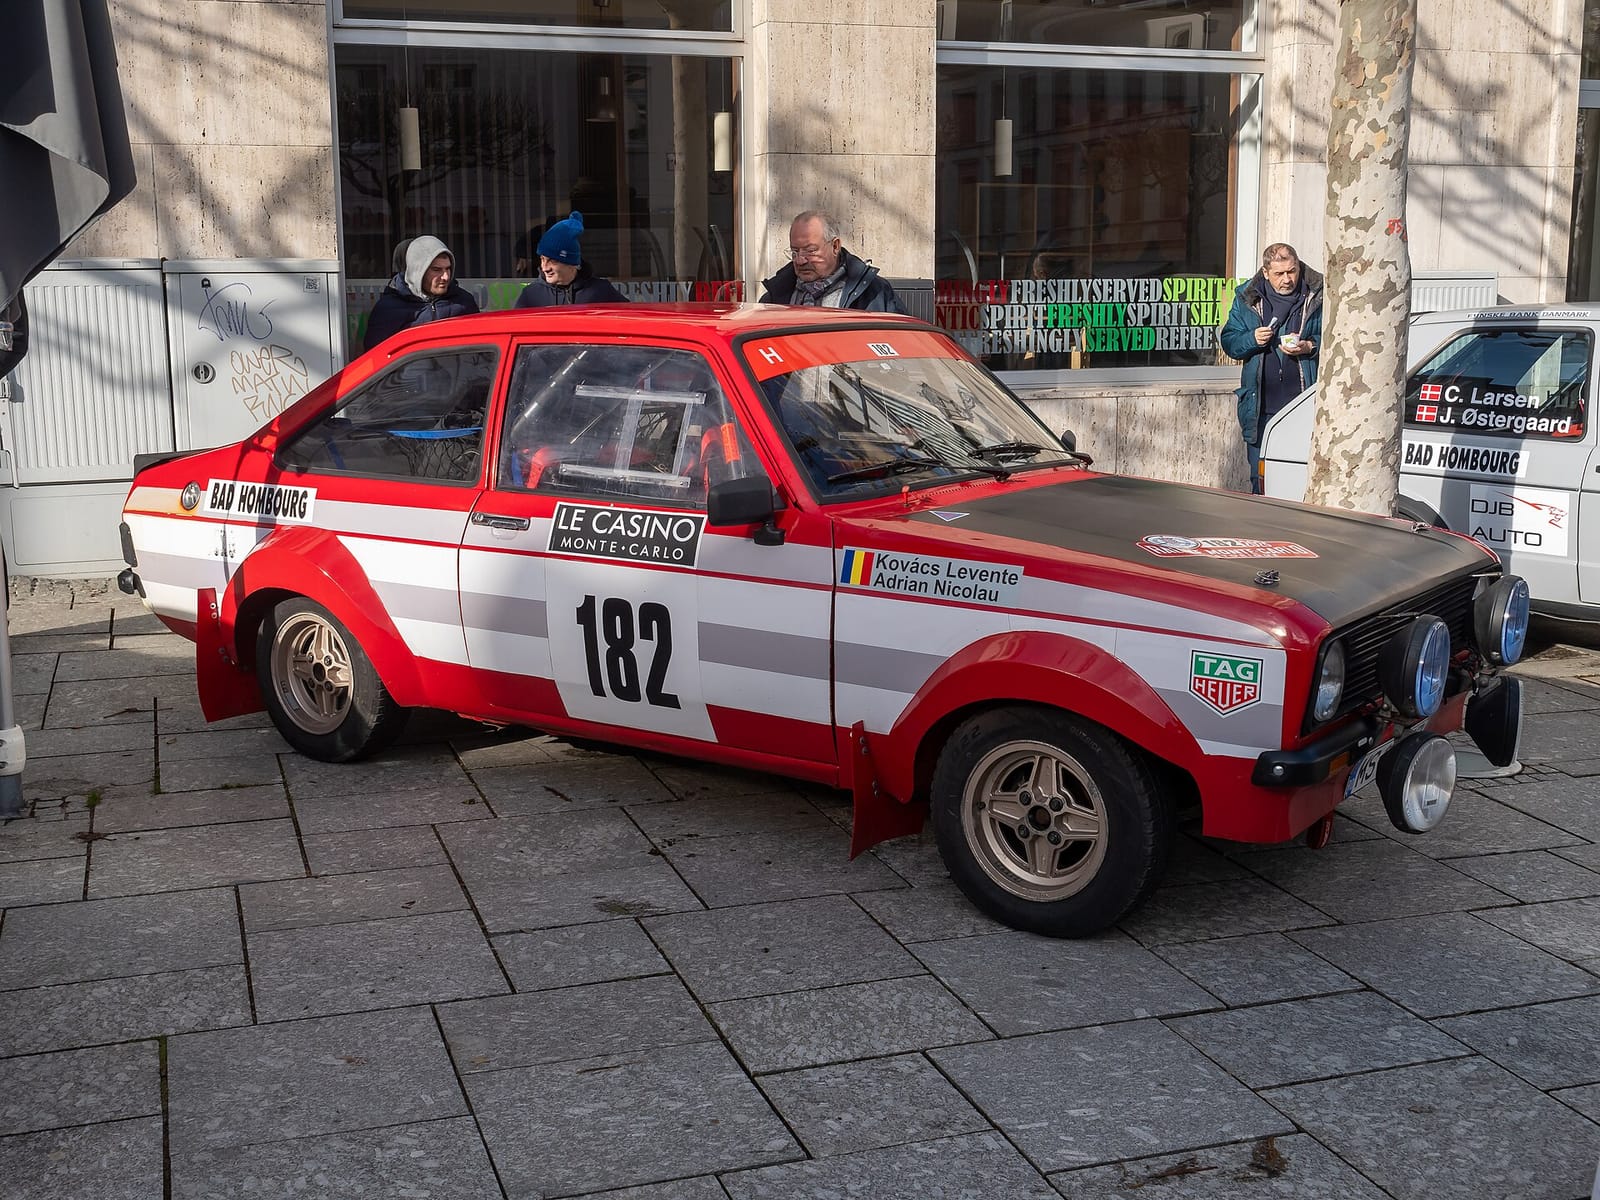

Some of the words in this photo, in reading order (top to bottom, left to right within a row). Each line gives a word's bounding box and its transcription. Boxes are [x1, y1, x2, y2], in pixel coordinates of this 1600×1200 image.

[1046, 303, 1128, 329] FRESHLY
[1542, 310, 1590, 318] DANMARK
[758, 346, 784, 365] H
[871, 344, 895, 356] 182
[1444, 385, 1464, 404] C.
[1470, 387, 1540, 409] Larsen
[1439, 406, 1455, 424] J.
[1461, 407, 1572, 434] Østergaard
[1404, 442, 1434, 467] BAD
[1437, 445, 1520, 475] HOMBOURG
[210, 482, 236, 511] BAD
[238, 485, 309, 519] HOMBOURG
[1471, 498, 1514, 517] DJB
[557, 507, 586, 532] LE
[592, 510, 696, 543] CASINO
[1472, 526, 1542, 547] AUTO
[875, 553, 941, 576] Kovács
[946, 561, 1019, 586] Levente
[873, 572, 929, 593] Adrian
[934, 579, 1000, 603] Nicolau
[575, 594, 682, 710] 182
[1198, 657, 1254, 681] TAG
[1195, 678, 1255, 708] HEUER
